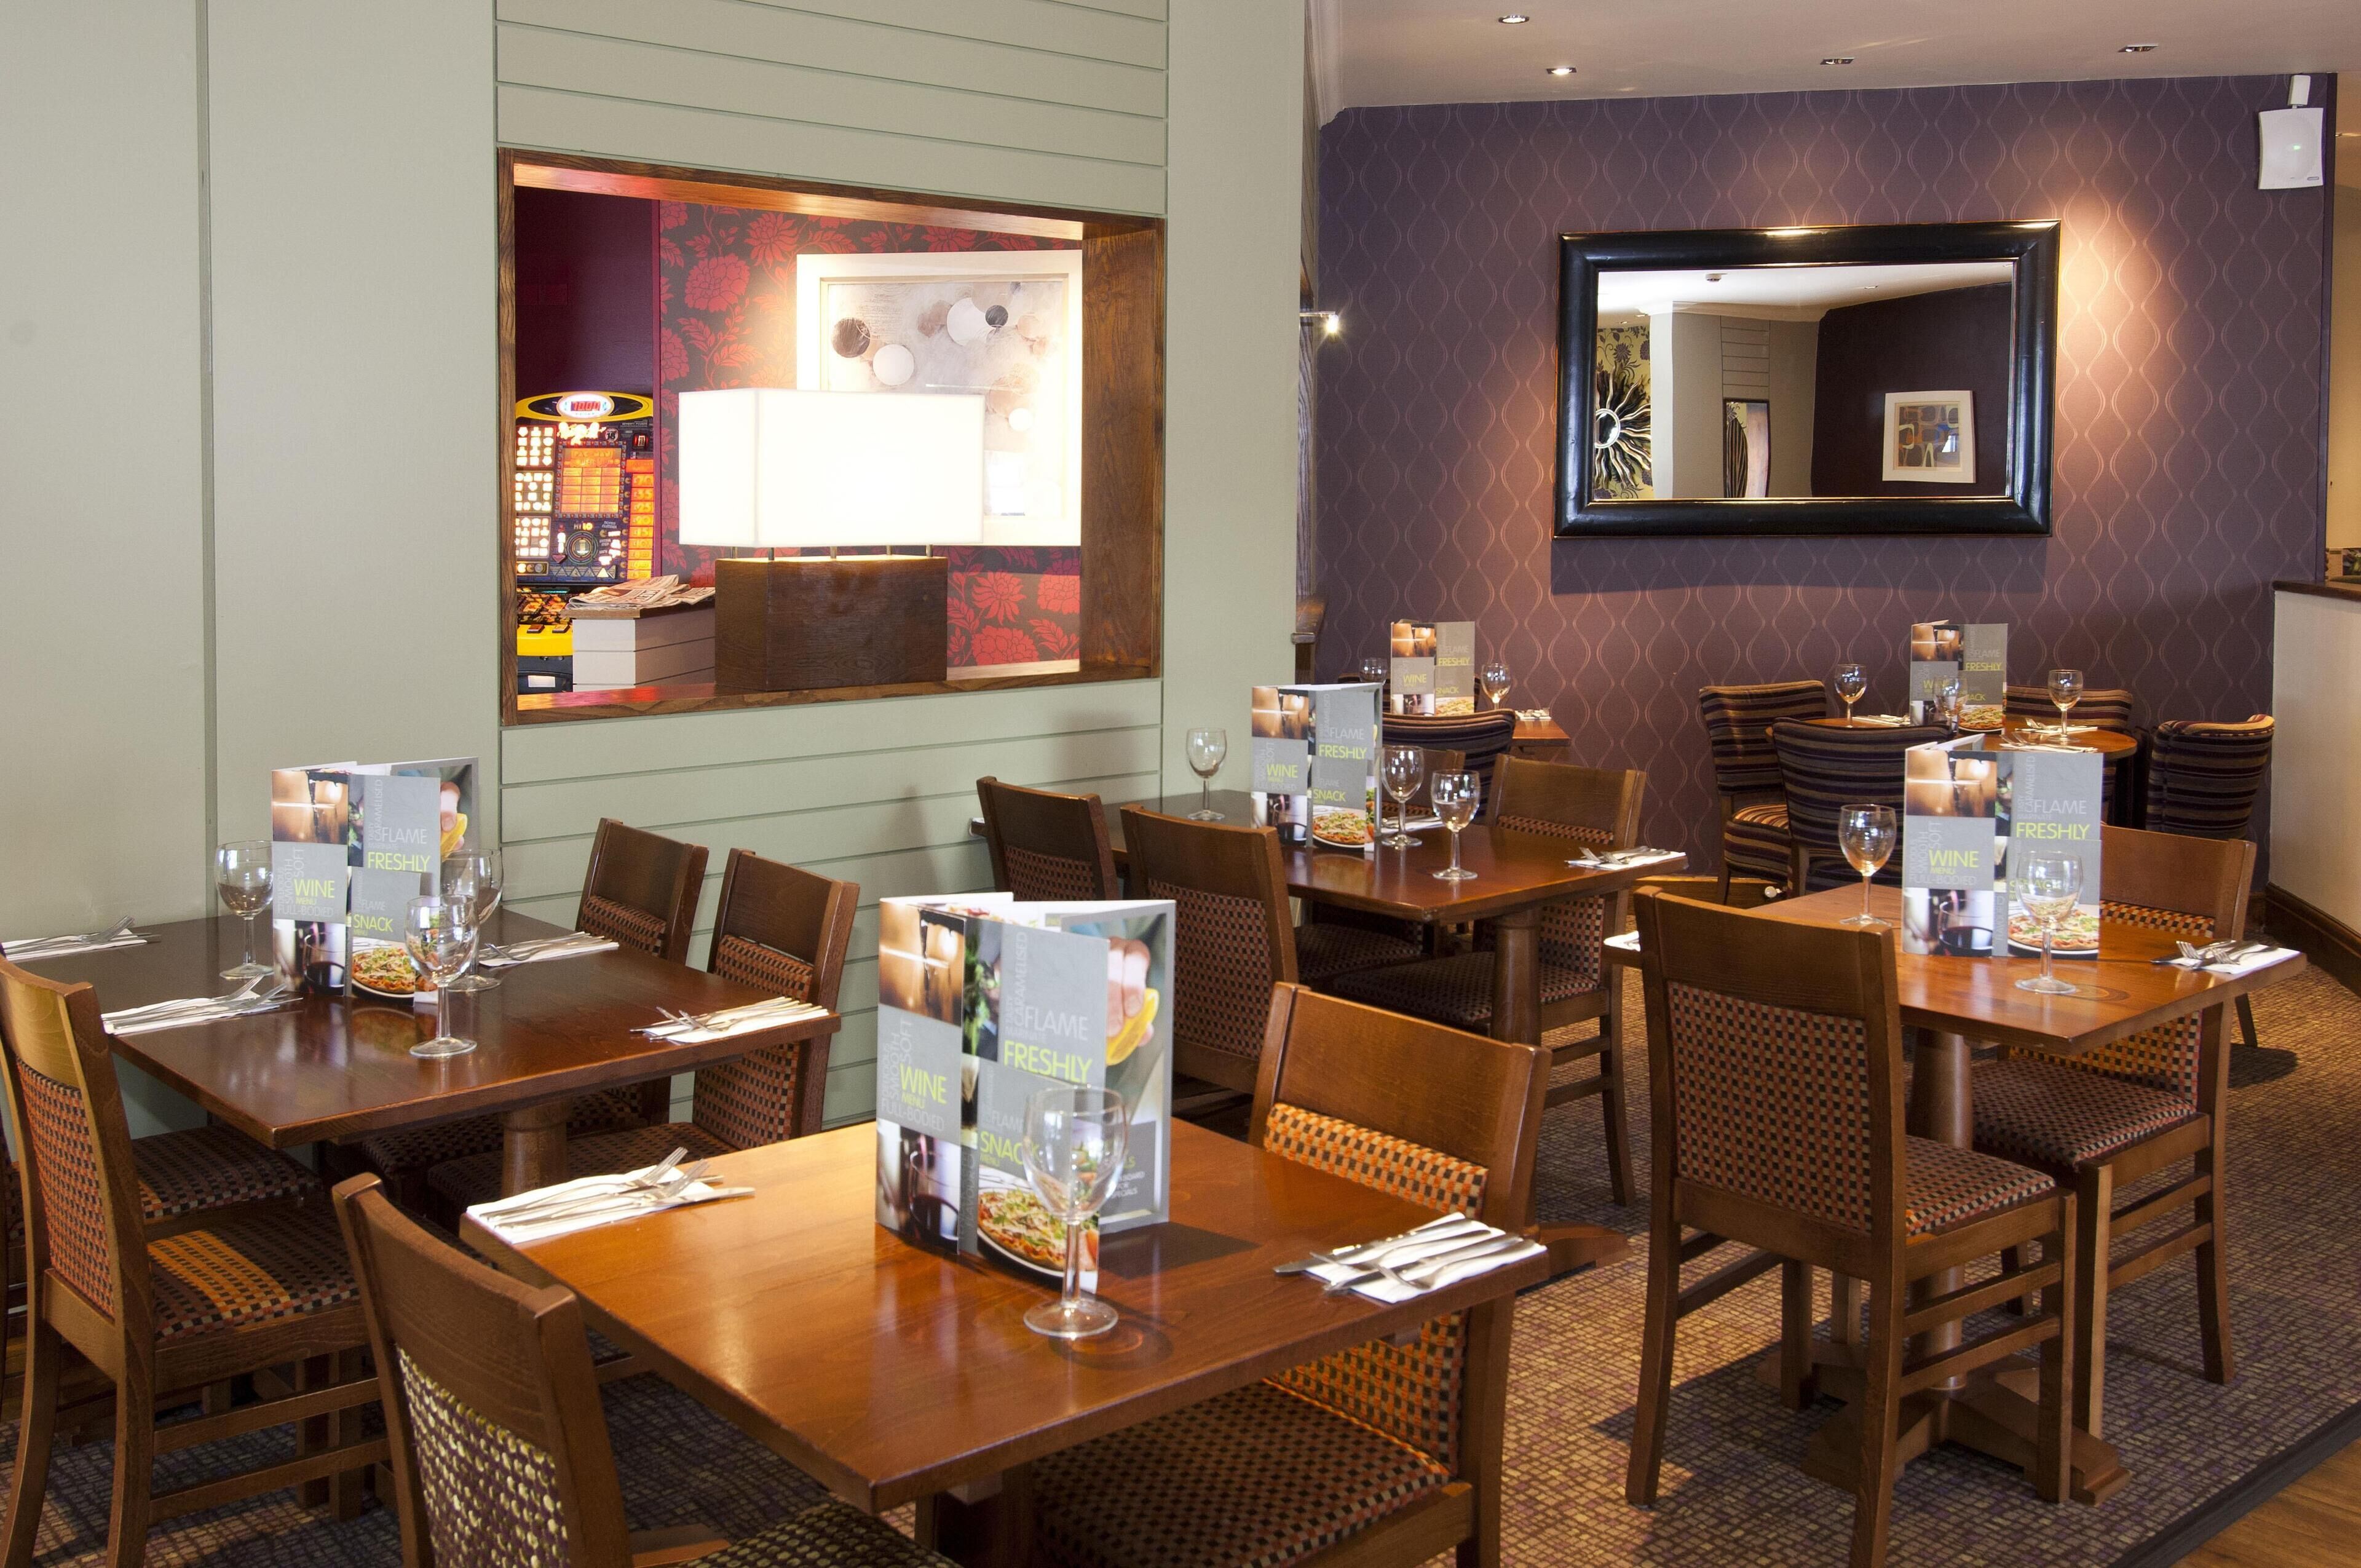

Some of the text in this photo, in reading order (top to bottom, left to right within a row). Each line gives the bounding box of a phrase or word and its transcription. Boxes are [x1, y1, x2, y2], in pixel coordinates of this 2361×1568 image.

[607, 430, 615, 440] 18
[1439, 657, 1470, 666] FRESHLY
[1403, 674, 1427, 683] WINE
[1436, 686, 1459, 695] SNACK
[1330, 727, 1364, 740] FLAME
[1319, 744, 1367, 759] FRESHLY
[1267, 763, 1298, 778] WINE
[1313, 788, 1346, 802] SNACK
[2034, 799, 2087, 814] FLAME
[382, 827, 427, 844] FLAME
[2016, 822, 2090, 840] FRESHLY
[294, 848, 304, 878] SOFT
[368, 852, 431, 872] FRESHLY
[1929, 849, 1979, 868] WINE
[285, 859, 293, 904] SMOOTH
[293, 879, 334, 898] WINE
[277, 905, 333, 917] FULL-BODIED
[354, 914, 393, 932] SNACK
[1015, 932, 1027, 1027] CARAMELISED
[1025, 1006, 1088, 1041] FLAME
[900, 1018, 913, 1065] SOFT
[890, 1032, 901, 1100] SMOOTH
[1003, 1040, 1093, 1083] FRESHLY
[900, 1063, 947, 1104] WINE
[901, 1091, 925, 1109] MENU
[881, 1098, 945, 1131] FULL-BODIED
